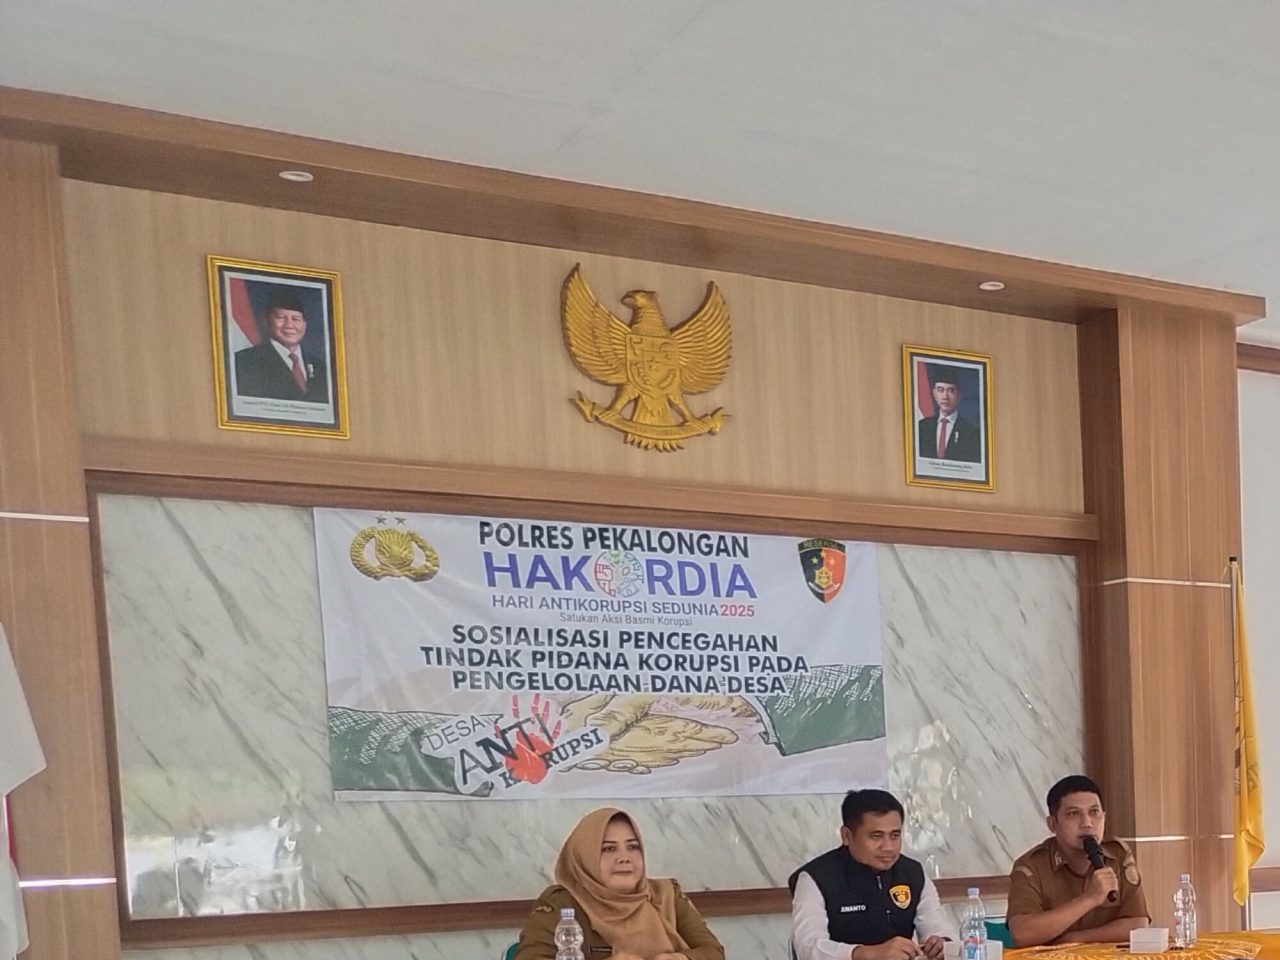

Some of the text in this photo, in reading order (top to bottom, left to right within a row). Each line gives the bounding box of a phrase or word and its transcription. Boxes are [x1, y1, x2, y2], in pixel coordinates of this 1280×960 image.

[479, 520, 750, 558] POLRES PEKALONGAN
[492, 594, 755, 617] HARI ANTIKORUPSI SEDUNIA 2025
[560, 612, 692, 628] Satukan Aksi Basmi Korupsi
[452, 624, 778, 652] SOSIALISASI PENCEGAHAN
[420, 646, 809, 673] TINDAK PIDANA KORUPSI PADA
[452, 670, 786, 694] PENGELOLAAN DANA DESA
[425, 715, 486, 751] DESA
[459, 713, 554, 786] ANTI
[499, 728, 604, 789] KRUPSI
